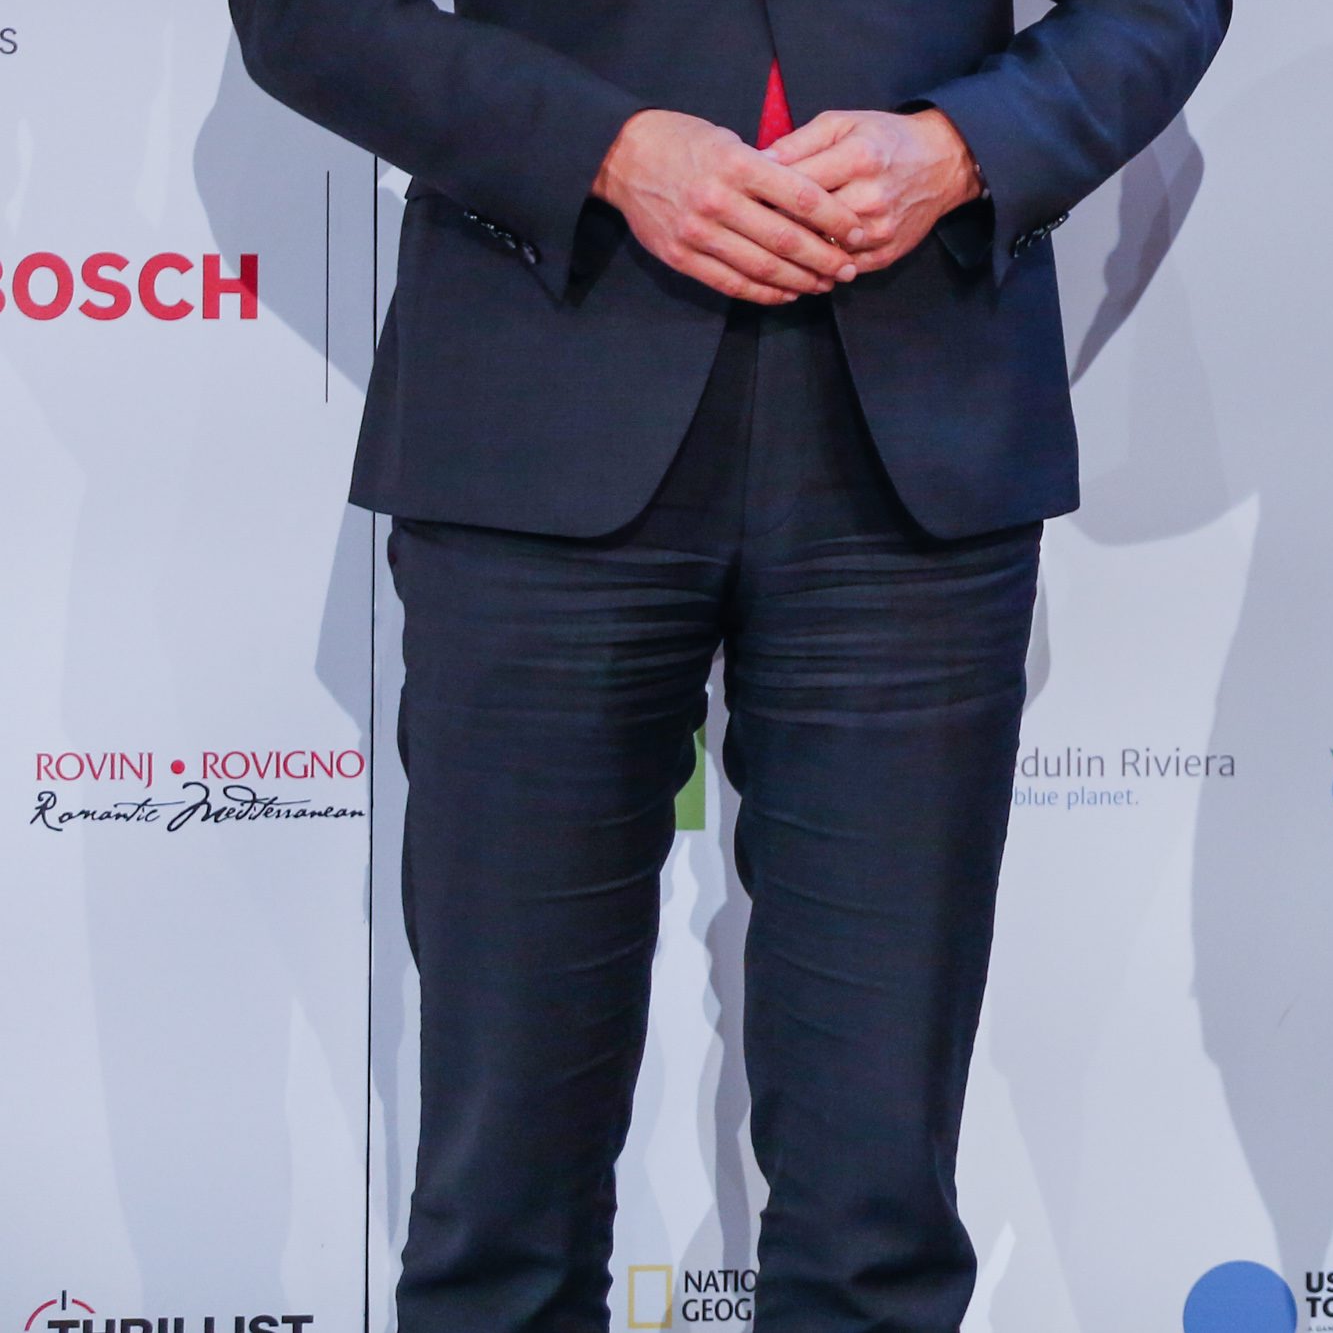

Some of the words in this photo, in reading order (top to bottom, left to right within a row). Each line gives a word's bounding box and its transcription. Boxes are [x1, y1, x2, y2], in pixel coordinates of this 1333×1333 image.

[0, 252, 259, 321] OSCH
[36, 752, 154, 788] ROVINJ
[202, 749, 366, 781] ROVIGNO
[1016, 746, 1105, 778] dulin
[1121, 747, 1235, 778] Riviera
[30, 791, 186, 832] Romantic
[166, 781, 367, 832] Mediterranean
[1014, 786, 1059, 806] blue
[1067, 787, 1139, 810] planet.
[684, 1269, 757, 1293] NATIO
[682, 1298, 752, 1322] GEOG
